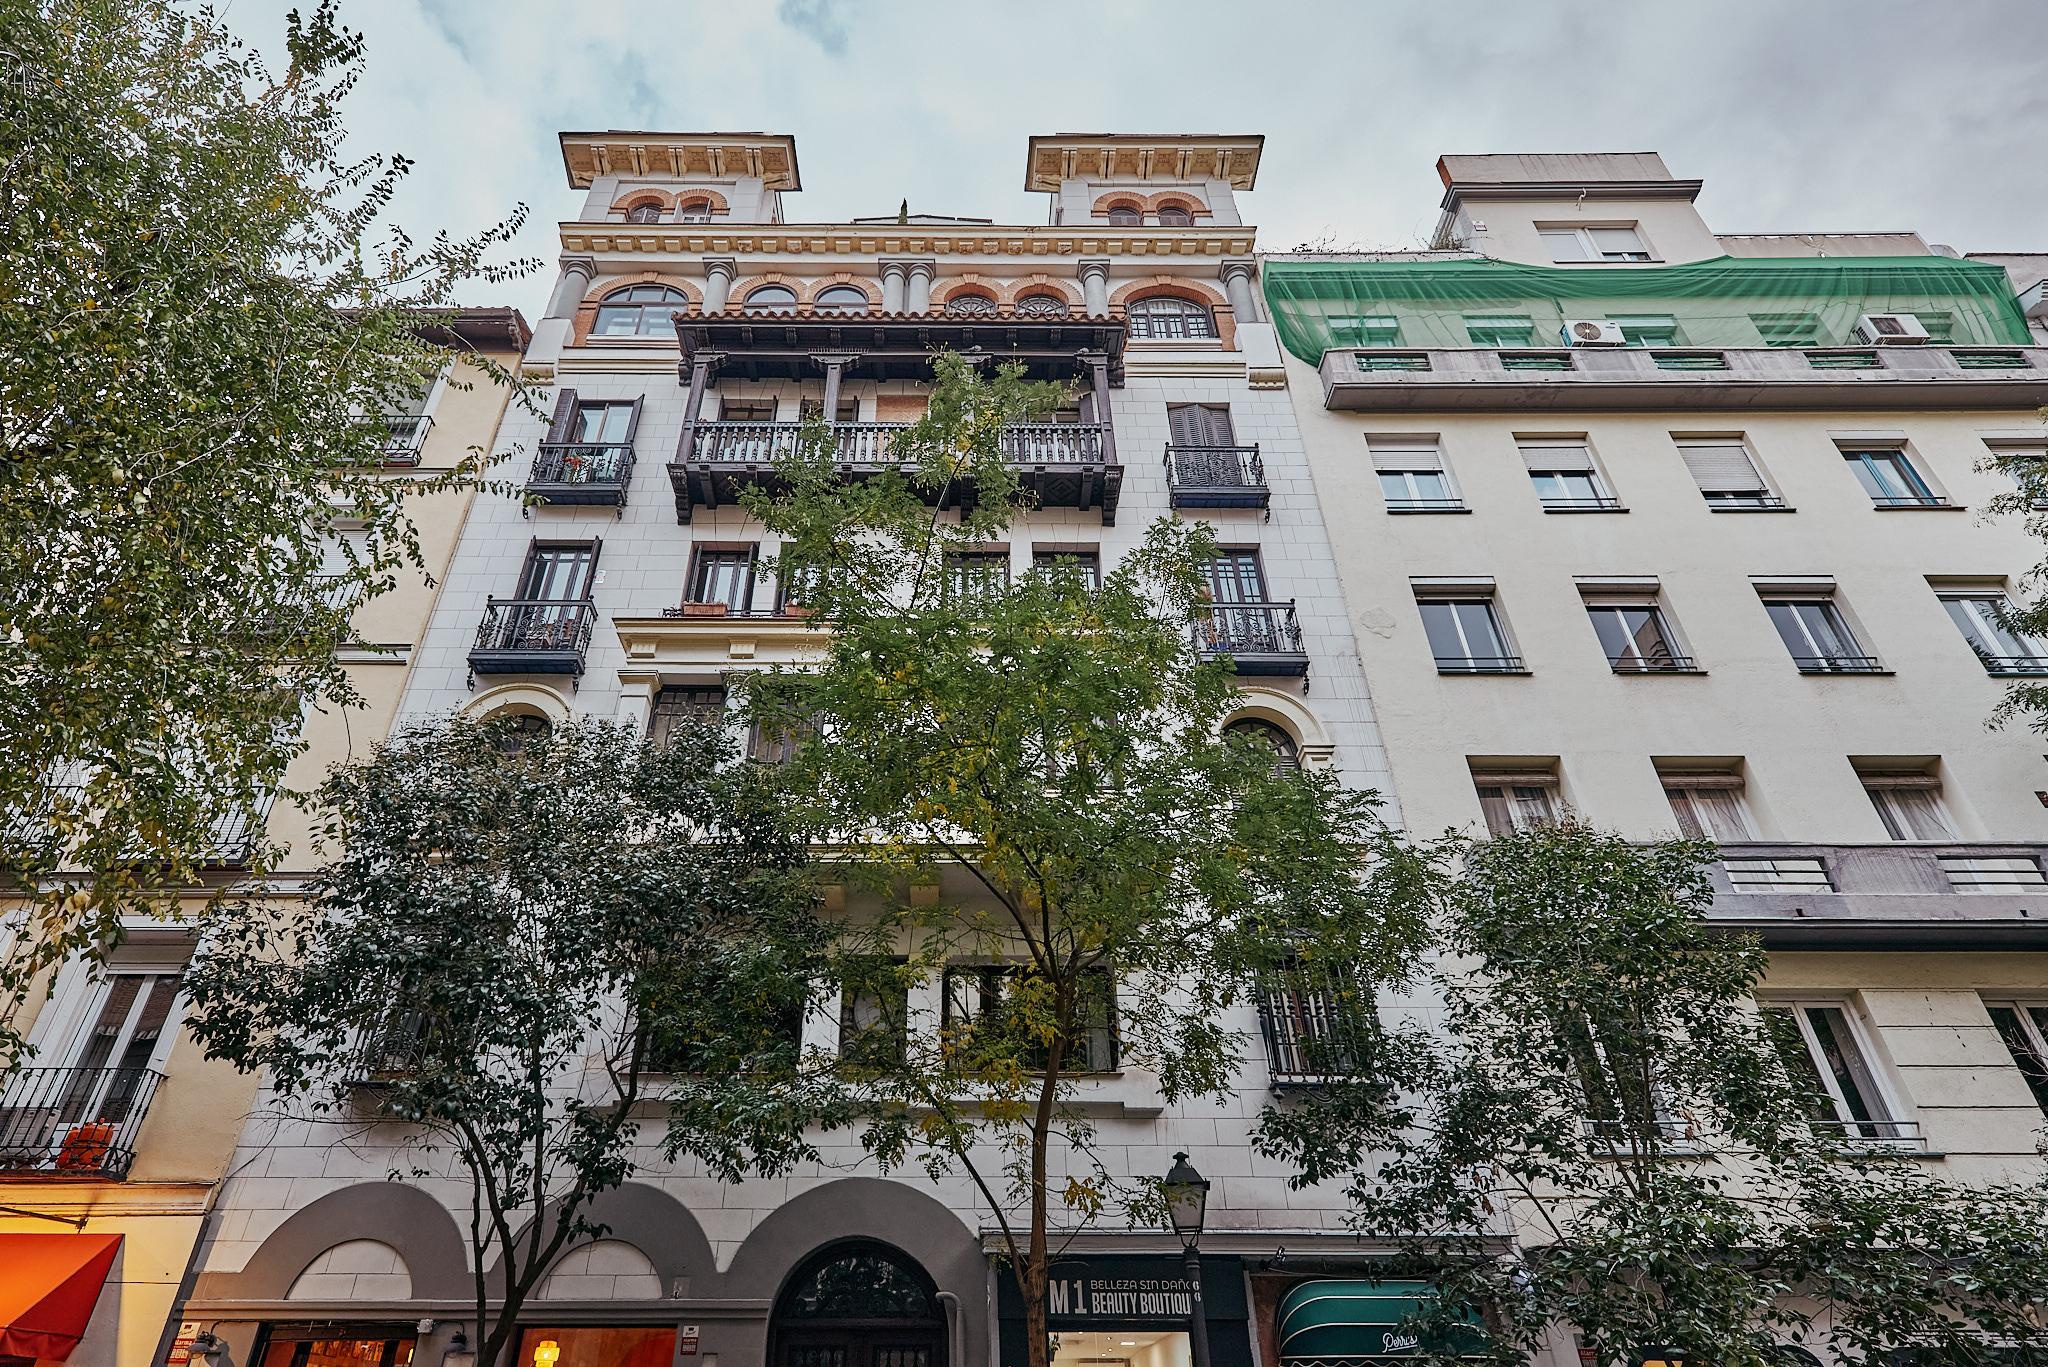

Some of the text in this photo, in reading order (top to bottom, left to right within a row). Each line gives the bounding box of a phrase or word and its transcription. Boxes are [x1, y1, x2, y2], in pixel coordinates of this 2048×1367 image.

[1090, 1280, 1137, 1290] BELLEZA
[1140, 1280, 1159, 1290] SIN
[1049, 1279, 1087, 1314] M1
[1091, 1292, 1191, 1314] BEAUTY BOUTIQU
